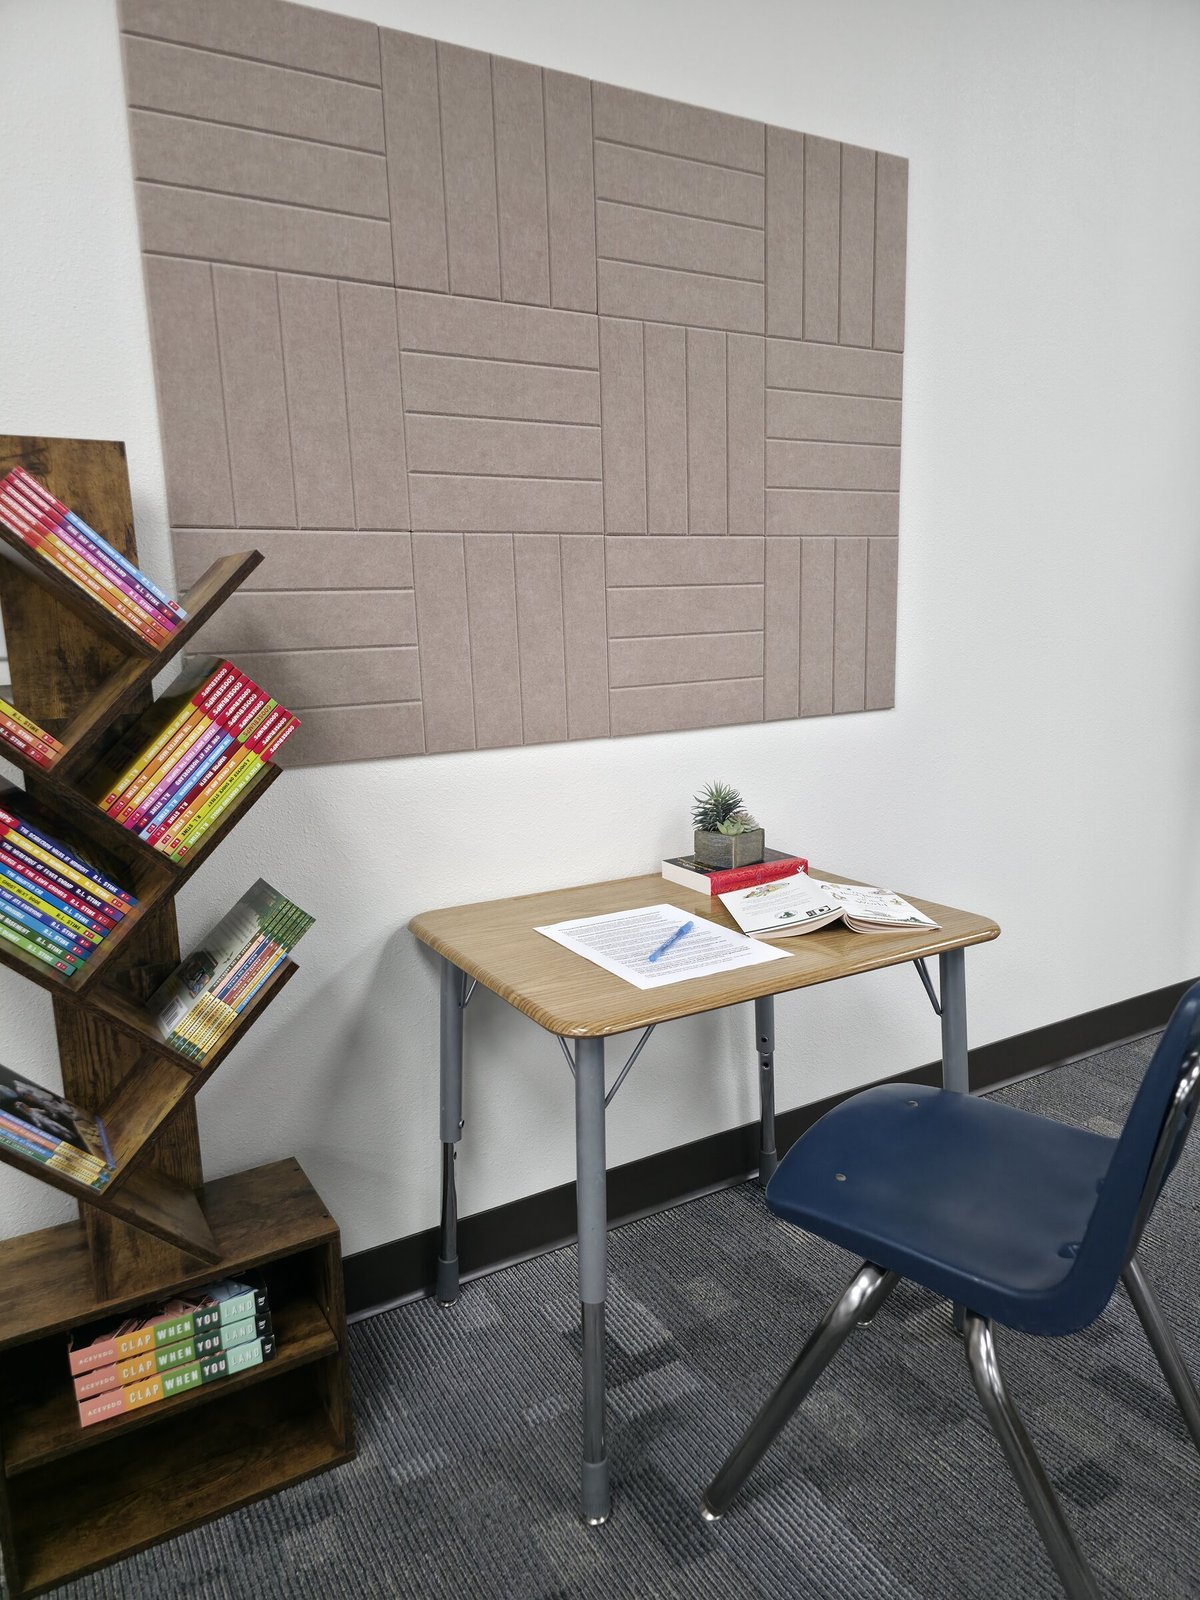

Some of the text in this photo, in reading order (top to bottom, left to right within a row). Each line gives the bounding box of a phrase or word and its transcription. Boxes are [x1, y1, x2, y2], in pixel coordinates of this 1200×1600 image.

[201, 667, 227, 696] GOOSEBUMPS
[204, 674, 234, 708] GOOSEBUMPS
[211, 681, 242, 715] GOOSEBUMPS
[224, 687, 250, 716] GOOSEBUMPS
[227, 692, 257, 726] GOOSEBUMPS
[238, 699, 263, 728] GOOSEBUMPS
[242, 704, 271, 737] GOOSEBUMPS
[253, 711, 278, 740] GOOSEBUMPS
[261, 717, 286, 745] GOOSEBUMPS
[269, 724, 294, 753] GOOSEBUMPS
[149, 801, 162, 815] STINE
[160, 791, 170, 802] R.L.
[178, 801, 187, 811] R.L.
[166, 810, 179, 824] STINE
[180, 822, 193, 836] STINE
[191, 813, 201, 823] R.L.
[75, 888, 86, 897] R.L.
[86, 895, 101, 907] STINE
[92, 874, 103, 883] R.L.
[102, 881, 117, 893] STINE
[63, 905, 74, 914] R.L.
[73, 912, 89, 924] STINE
[70, 898, 81, 907] R.L.
[80, 904, 95, 917] STINE
[50, 920, 61, 930] R.L.
[61, 927, 76, 940] STINE
[78, 1300, 254, 1365] ACEVEDO CLAP WHEN YOU LAND
[81, 1324, 254, 1391] ACEVEDO CLAP WHEN YOU LAND
[88, 1348, 259, 1417] ACEVEDO CLAP WHEN YOU LAND
